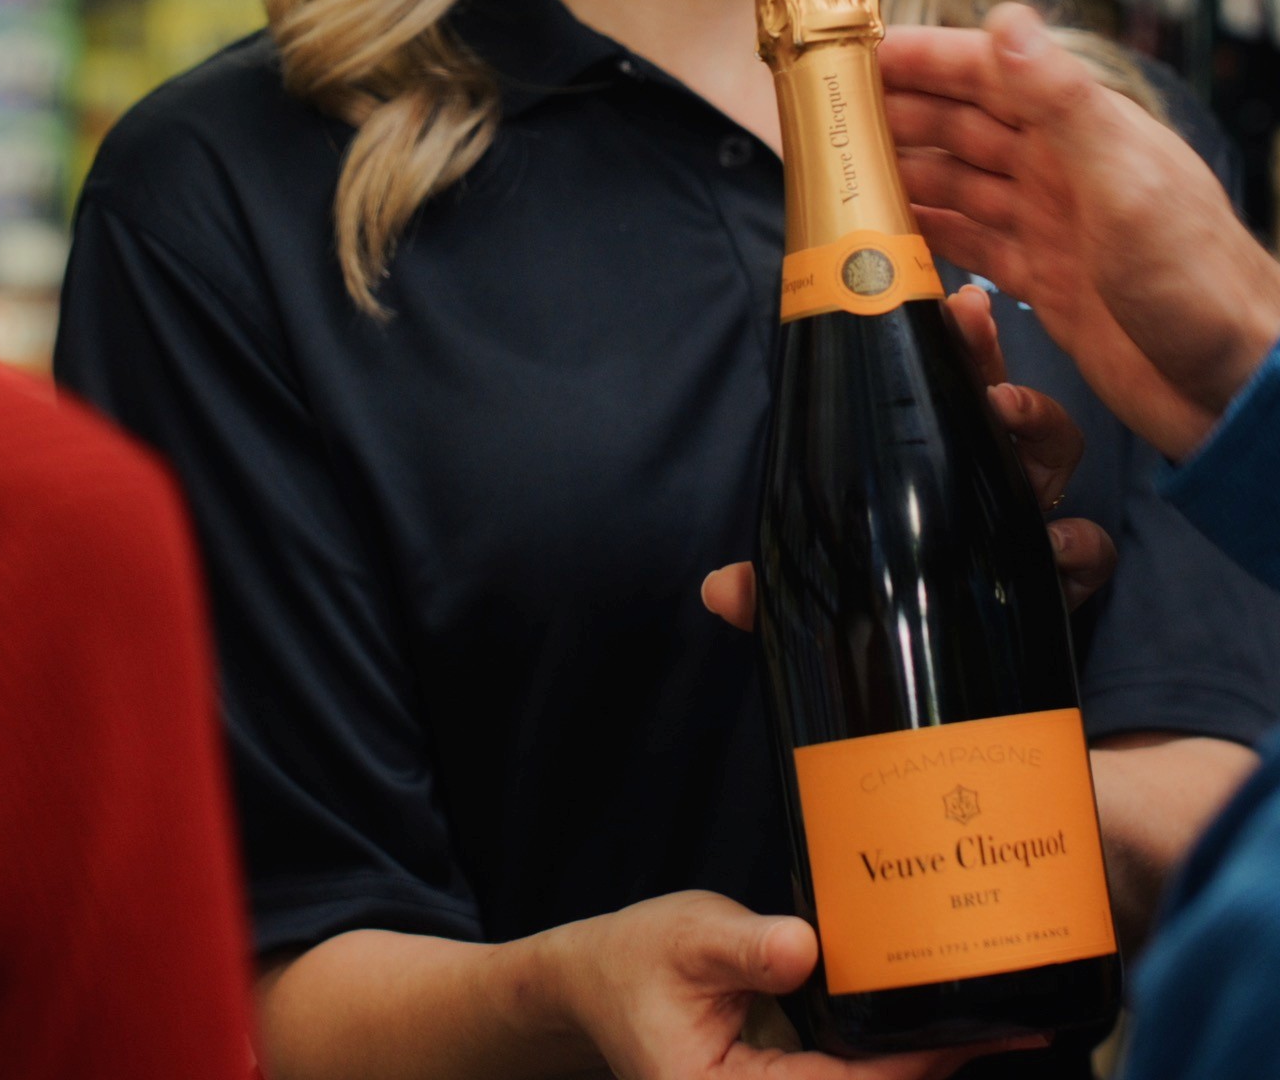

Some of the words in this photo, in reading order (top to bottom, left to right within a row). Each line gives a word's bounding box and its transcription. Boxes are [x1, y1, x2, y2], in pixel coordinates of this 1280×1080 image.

[822, 73, 850, 148] Clicquot
[840, 151, 860, 205] Veuve
[859, 744, 1044, 793] CHAMPAGNE
[858, 849, 945, 882] Veuve
[955, 829, 1067, 869] Clicquot
[950, 888, 1001, 909] BRUT
[1026, 926, 1070, 942] FRANCE
